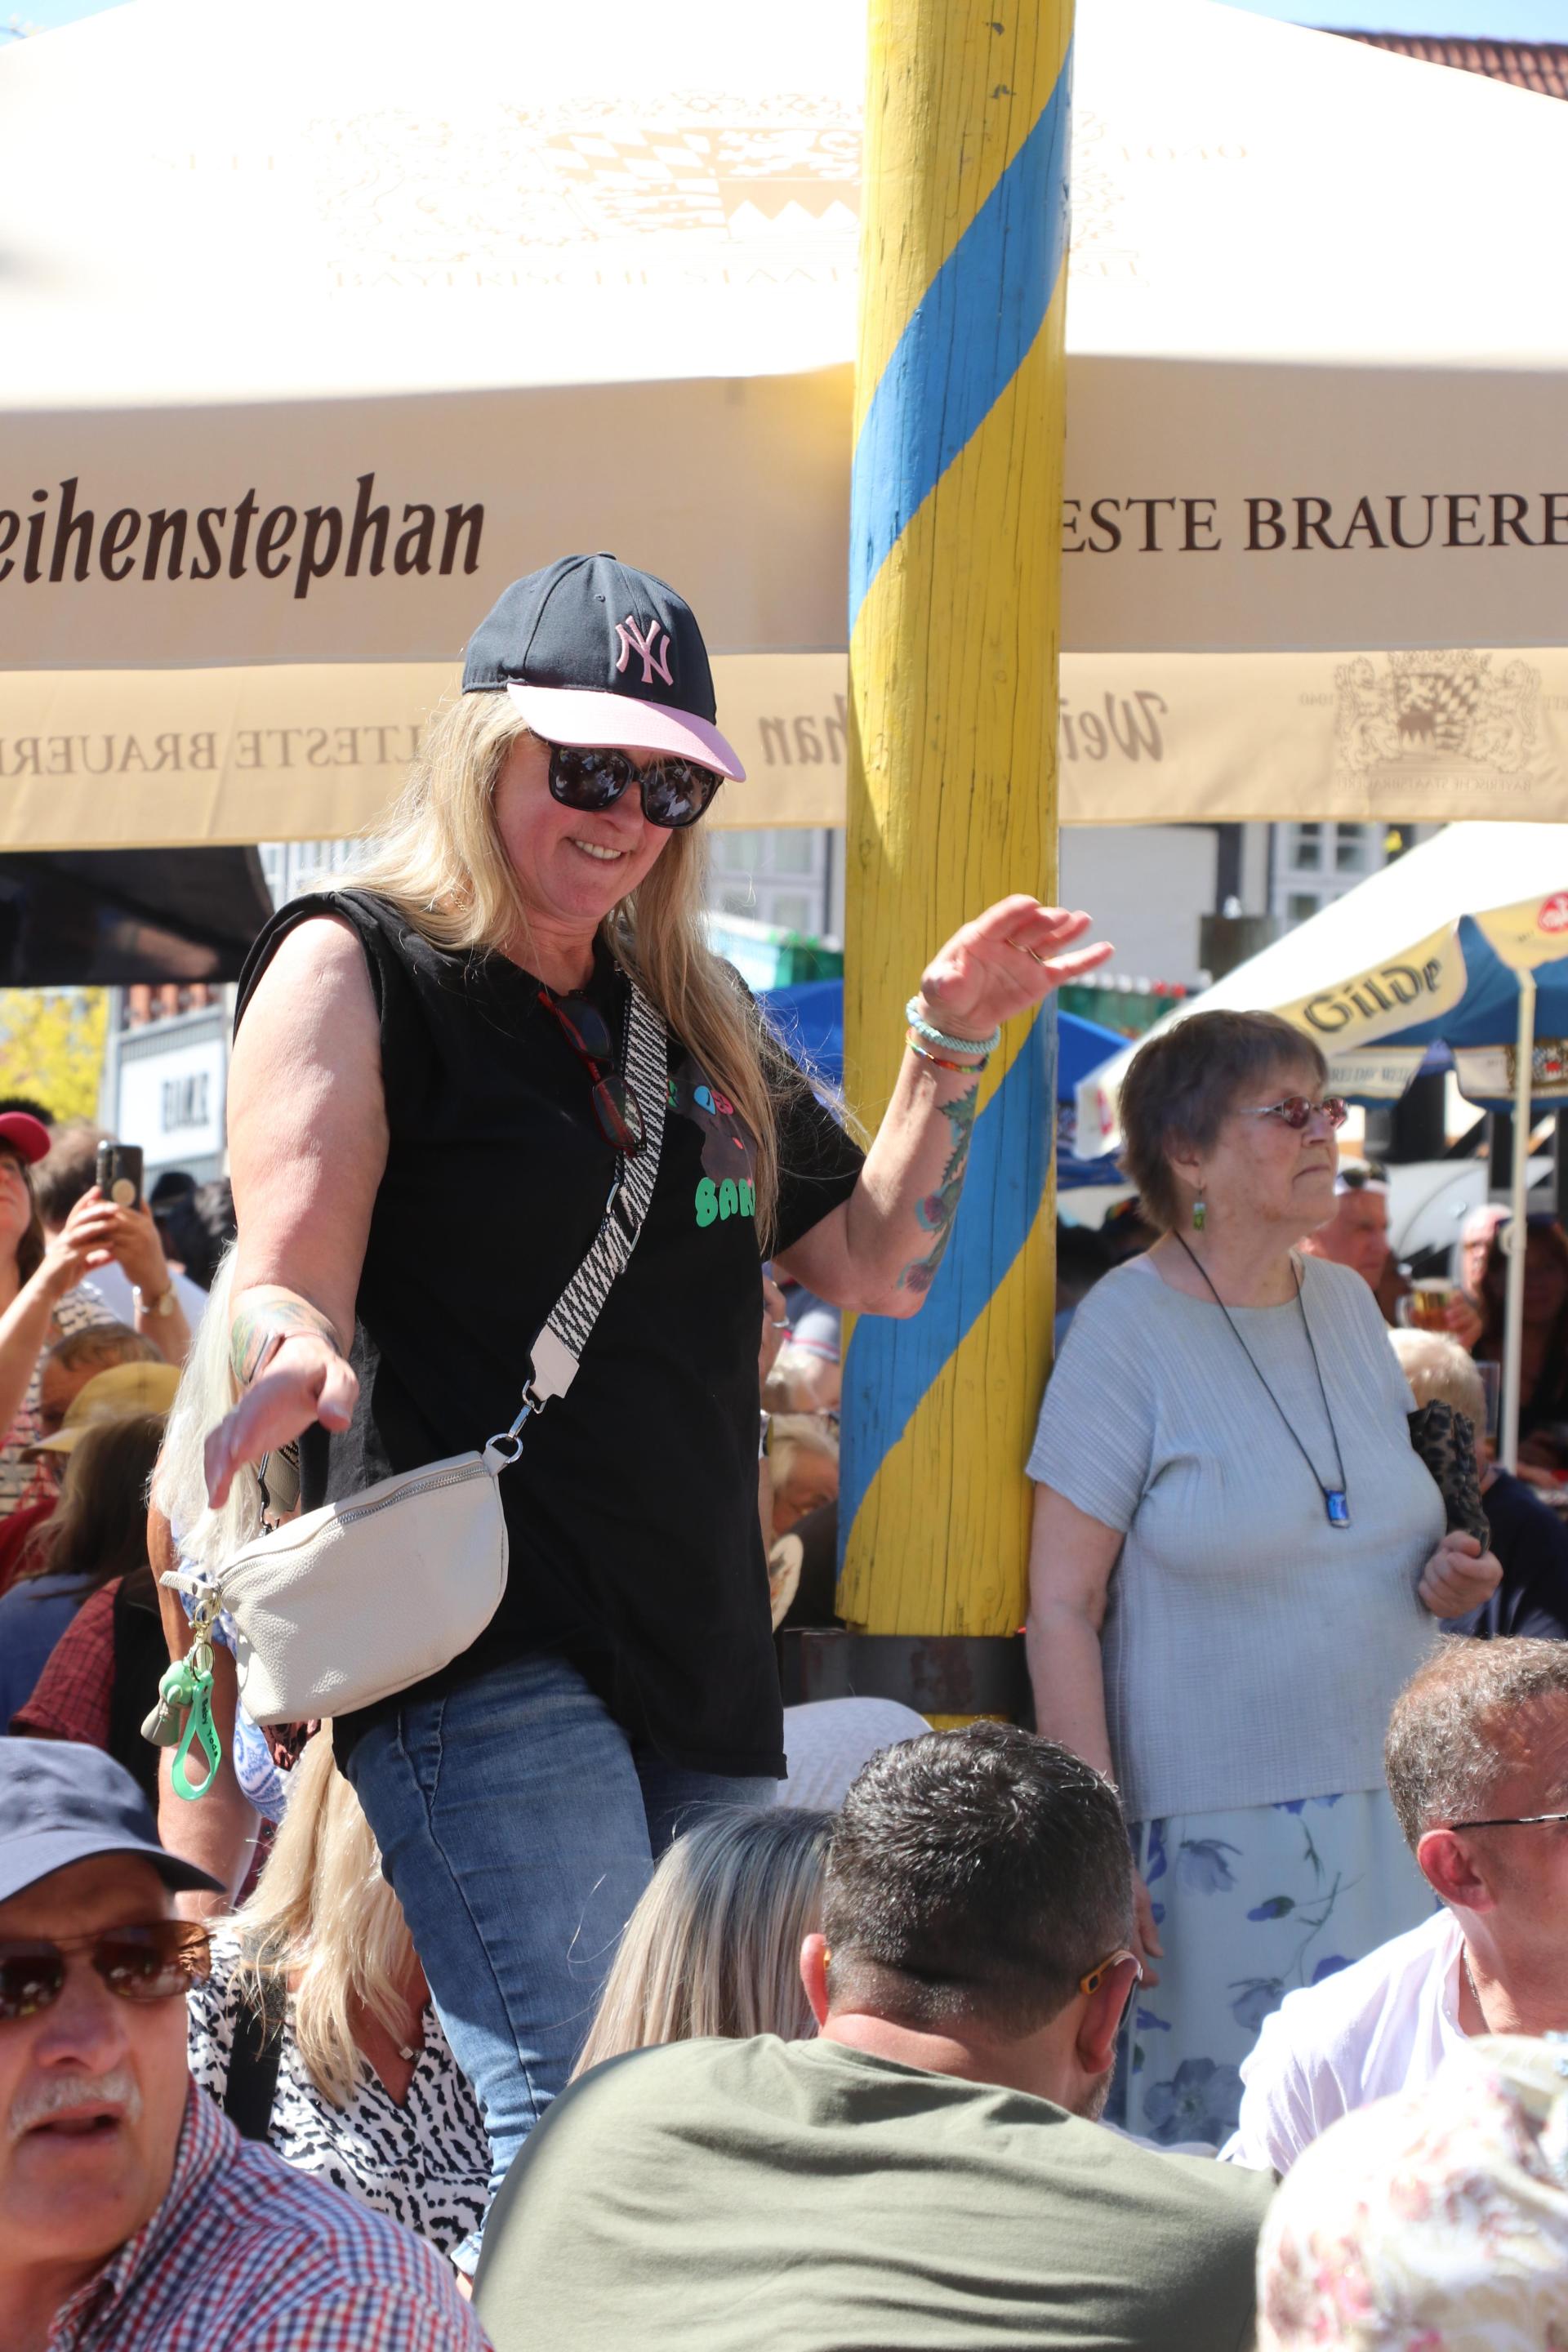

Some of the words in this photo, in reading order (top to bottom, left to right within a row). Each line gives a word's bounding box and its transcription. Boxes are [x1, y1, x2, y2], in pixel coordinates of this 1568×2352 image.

[1062, 497, 1223, 553] ESTE
[1243, 492, 1568, 551] BRAUERE
[616, 615, 674, 686] NY
